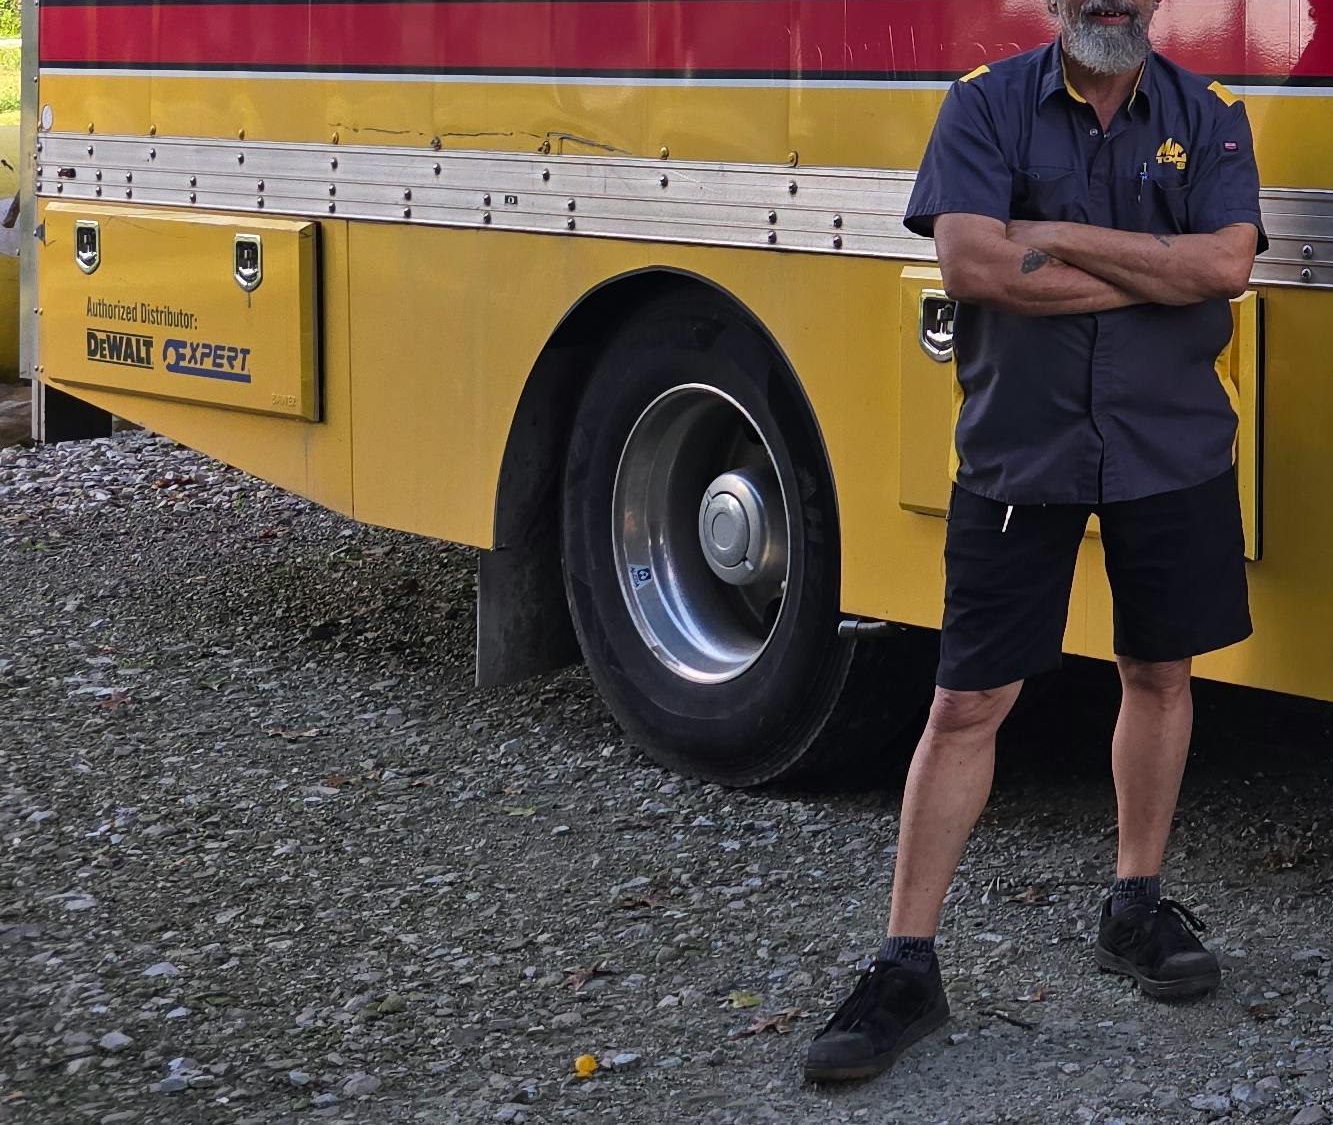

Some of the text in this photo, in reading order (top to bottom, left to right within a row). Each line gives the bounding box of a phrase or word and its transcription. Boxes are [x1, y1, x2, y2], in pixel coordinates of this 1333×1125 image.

[87, 296, 198, 330] Authorized Distributor:
[163, 338, 251, 375] EXPERT
